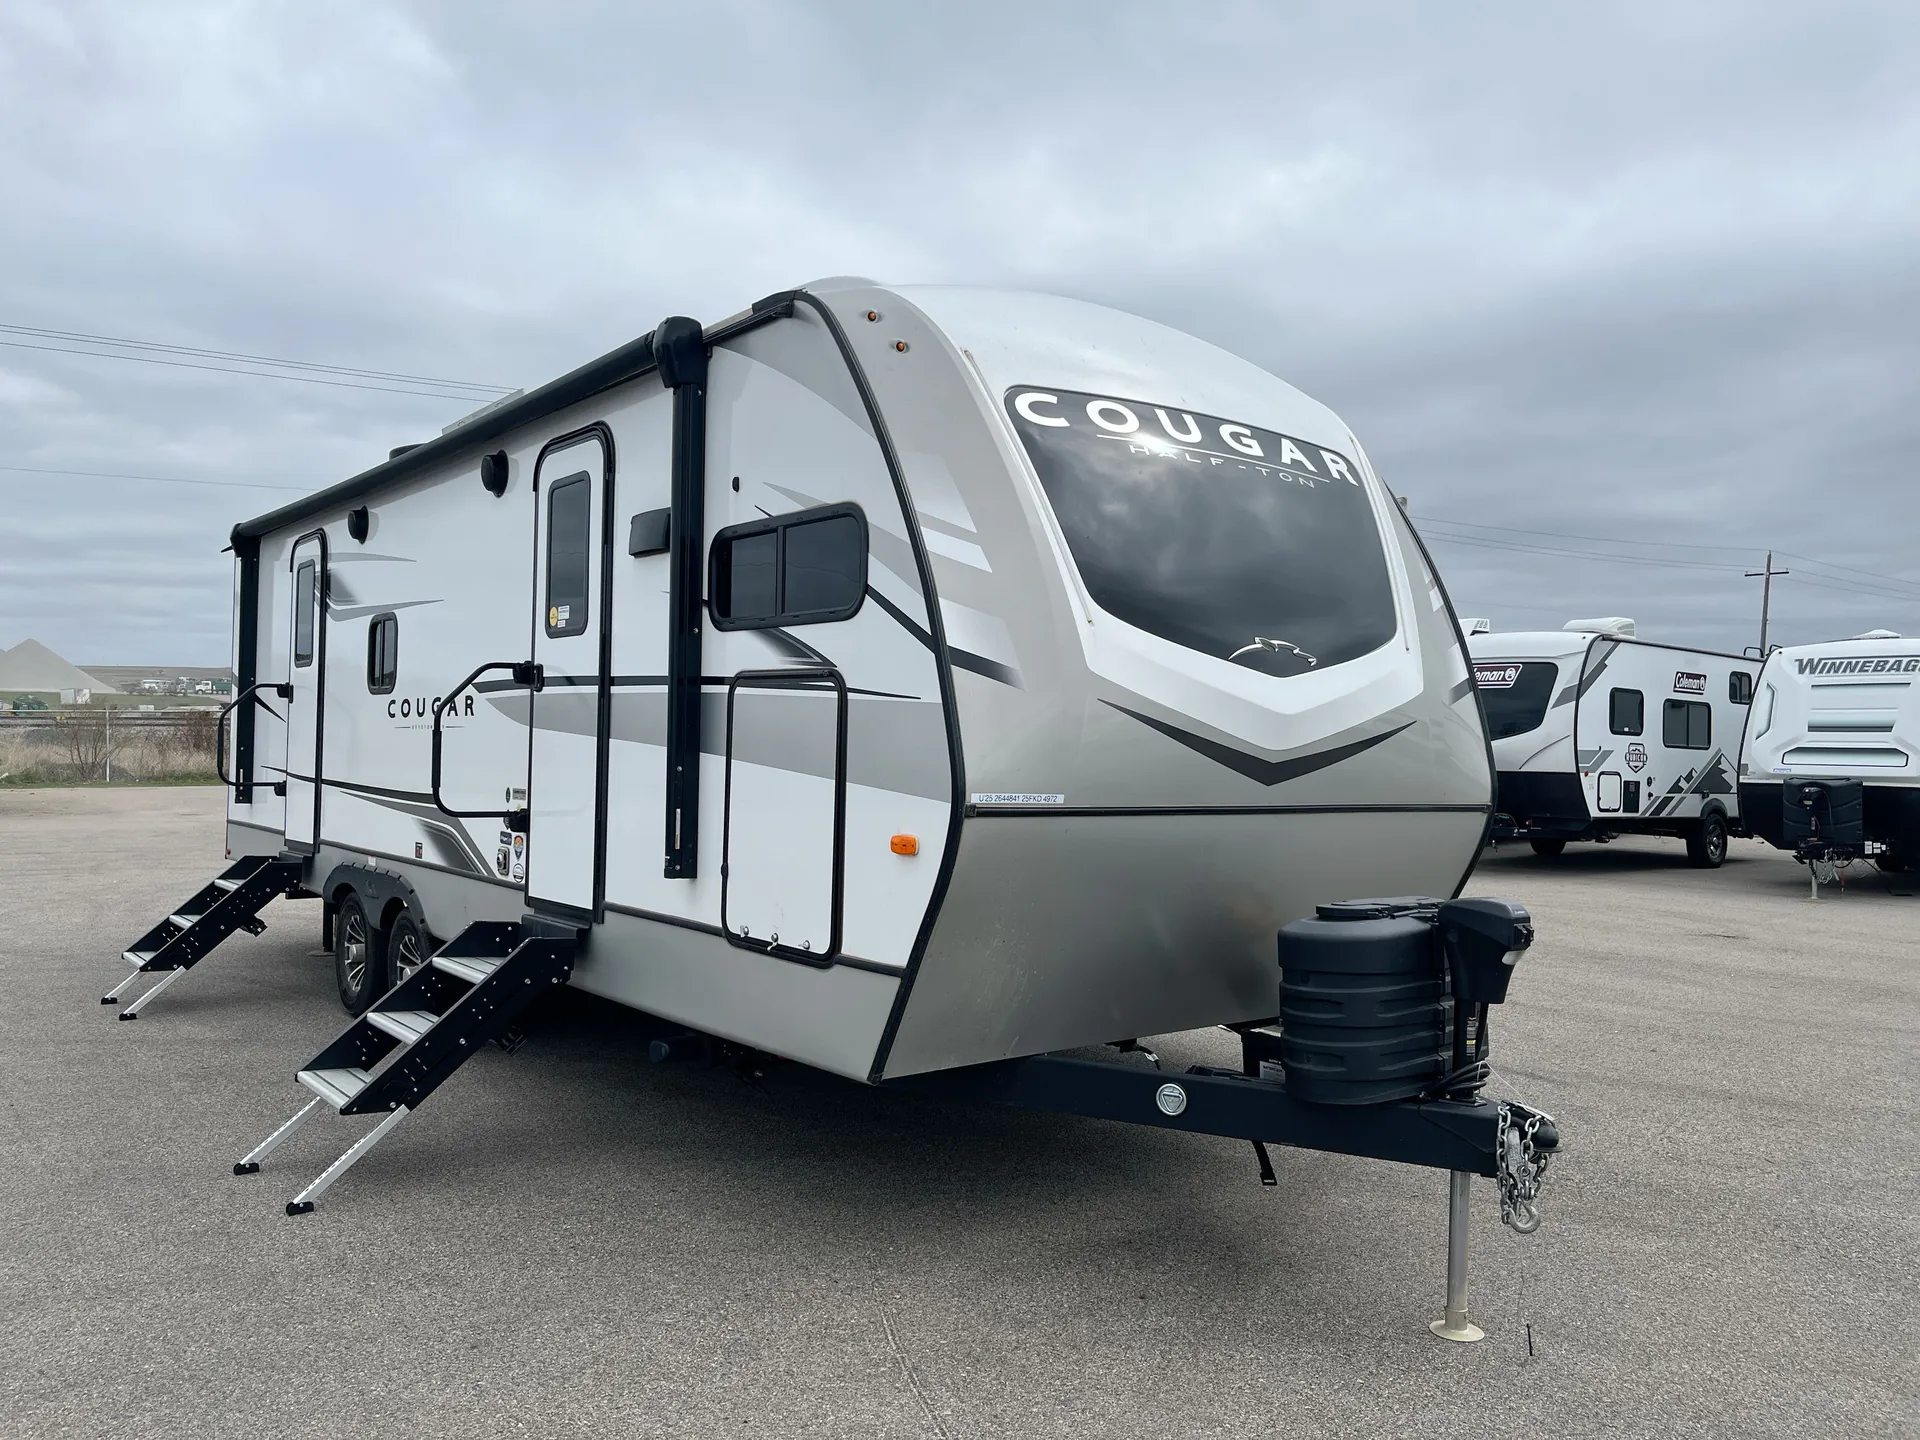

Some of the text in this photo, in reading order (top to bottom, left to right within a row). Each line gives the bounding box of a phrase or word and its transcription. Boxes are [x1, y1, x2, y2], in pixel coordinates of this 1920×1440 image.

[1014, 391, 1359, 487] COUGAR
[1129, 444, 1316, 488] HALF-TON
[1474, 668, 1505, 682] eman
[1795, 658, 1920, 675] WINNEBAG
[1676, 673, 1700, 689] Coleman
[387, 695, 475, 718] COUGAR
[994, 794, 1020, 803] 2644841
[1021, 795, 1042, 803] 25FKD
[1043, 795, 1058, 803] 4972
